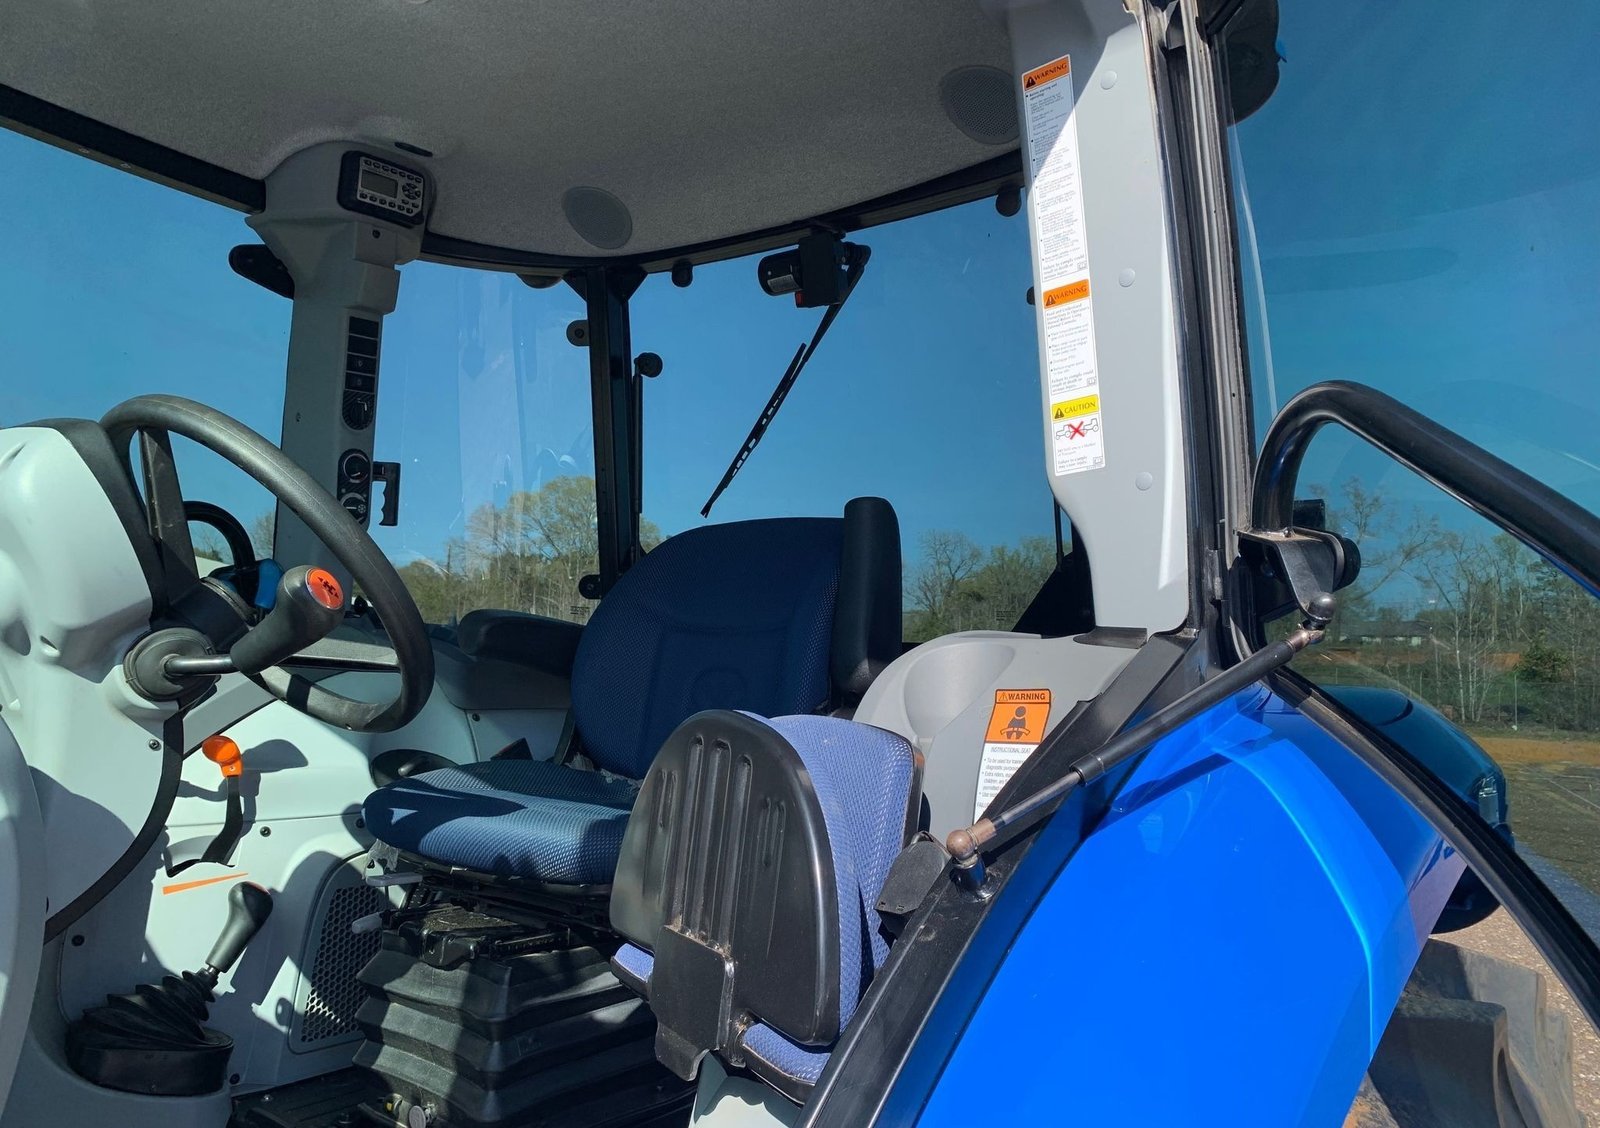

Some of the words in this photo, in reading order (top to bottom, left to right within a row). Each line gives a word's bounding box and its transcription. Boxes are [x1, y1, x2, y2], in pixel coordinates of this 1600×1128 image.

[1034, 62, 1067, 80] WARNING
[1054, 285, 1087, 299] WARNING
[1064, 402, 1096, 414] CAUTION
